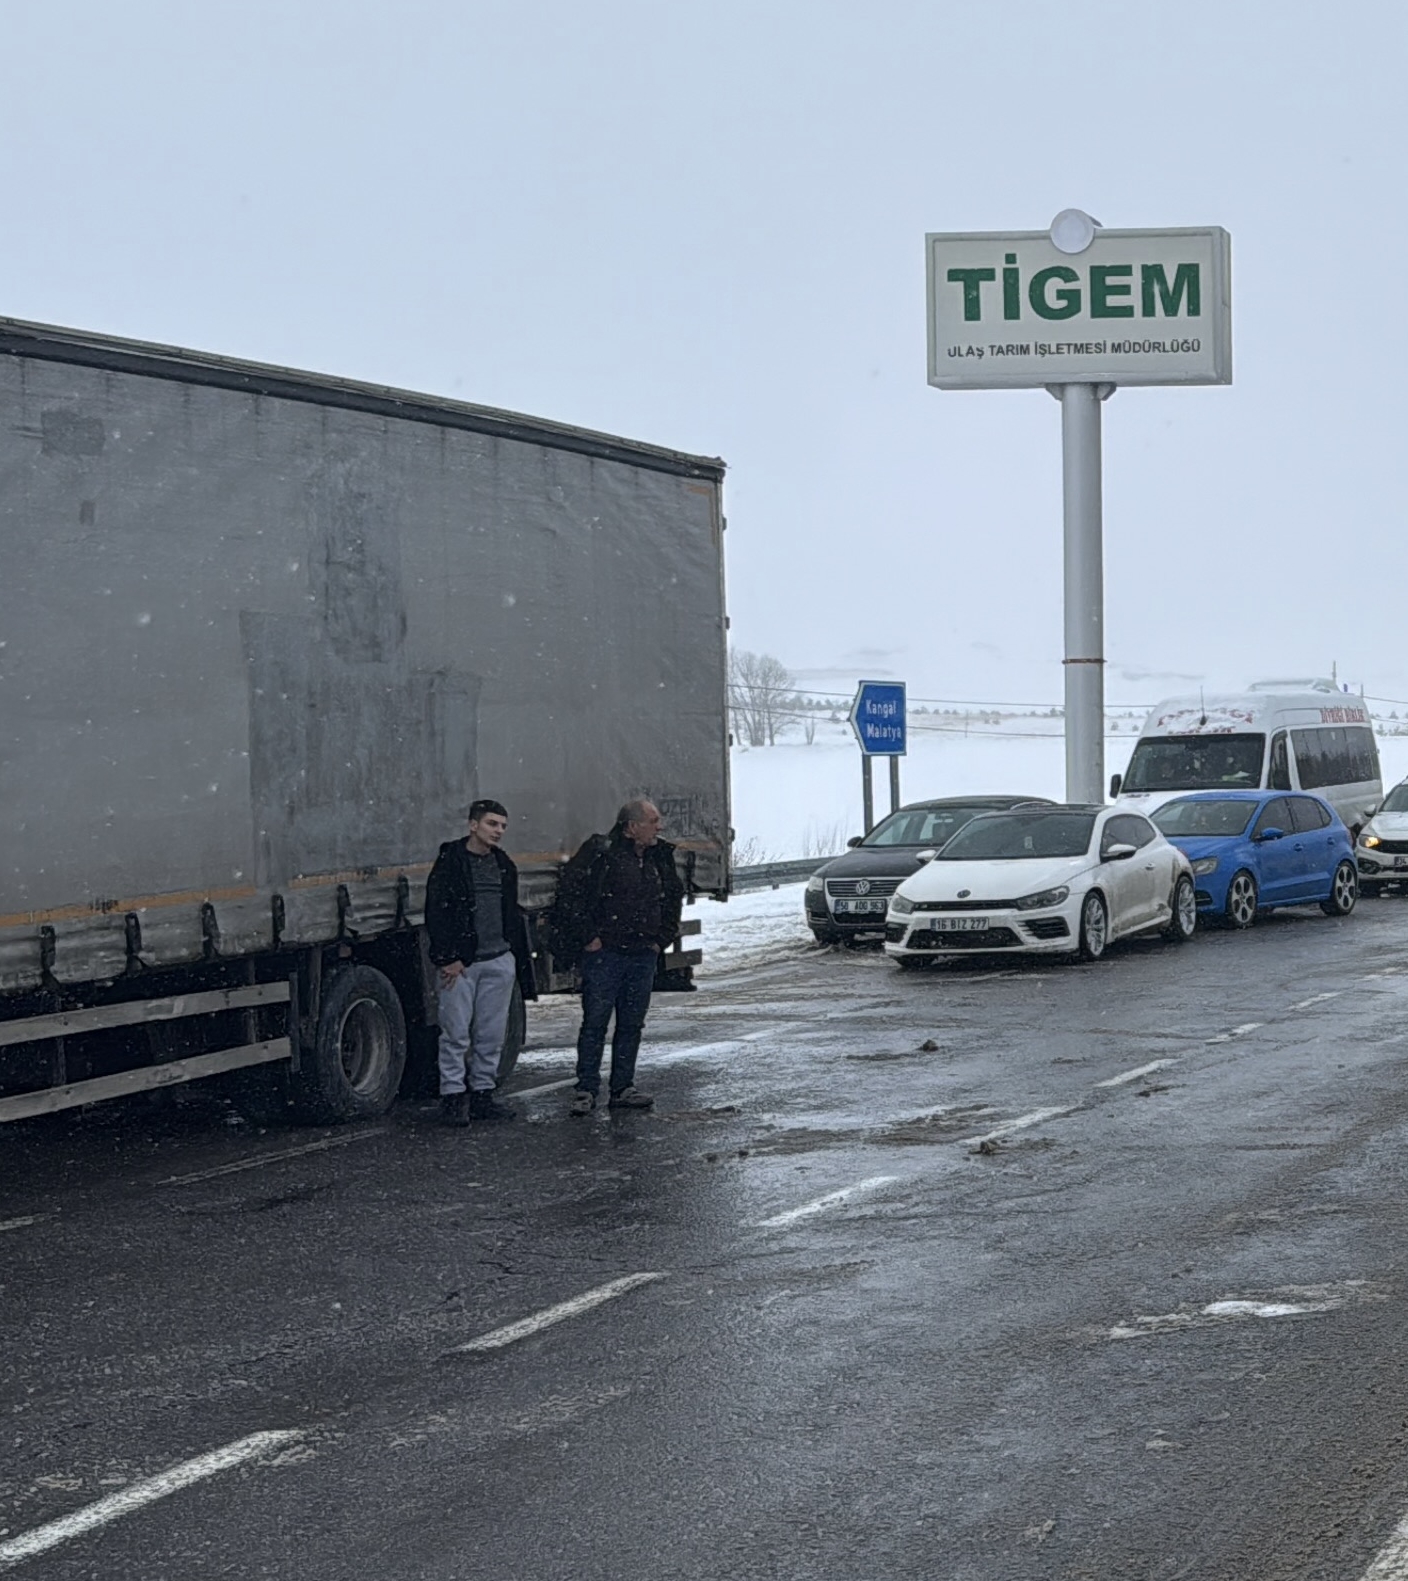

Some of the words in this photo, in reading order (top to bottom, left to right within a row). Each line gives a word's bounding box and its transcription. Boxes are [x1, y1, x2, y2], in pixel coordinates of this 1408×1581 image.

[947, 253, 1201, 322] TİGEM
[947, 345, 985, 360] ULAŞ
[988, 343, 1031, 357] TARIM
[1034, 340, 1107, 358] İŞLETMESİ
[1110, 338, 1201, 354] MÜDÜRLÜĞÜ
[866, 699, 897, 718] Kangal
[866, 723, 902, 742] Malatya
[937, 918, 947, 930] 16
[970, 917, 987, 929] 277
